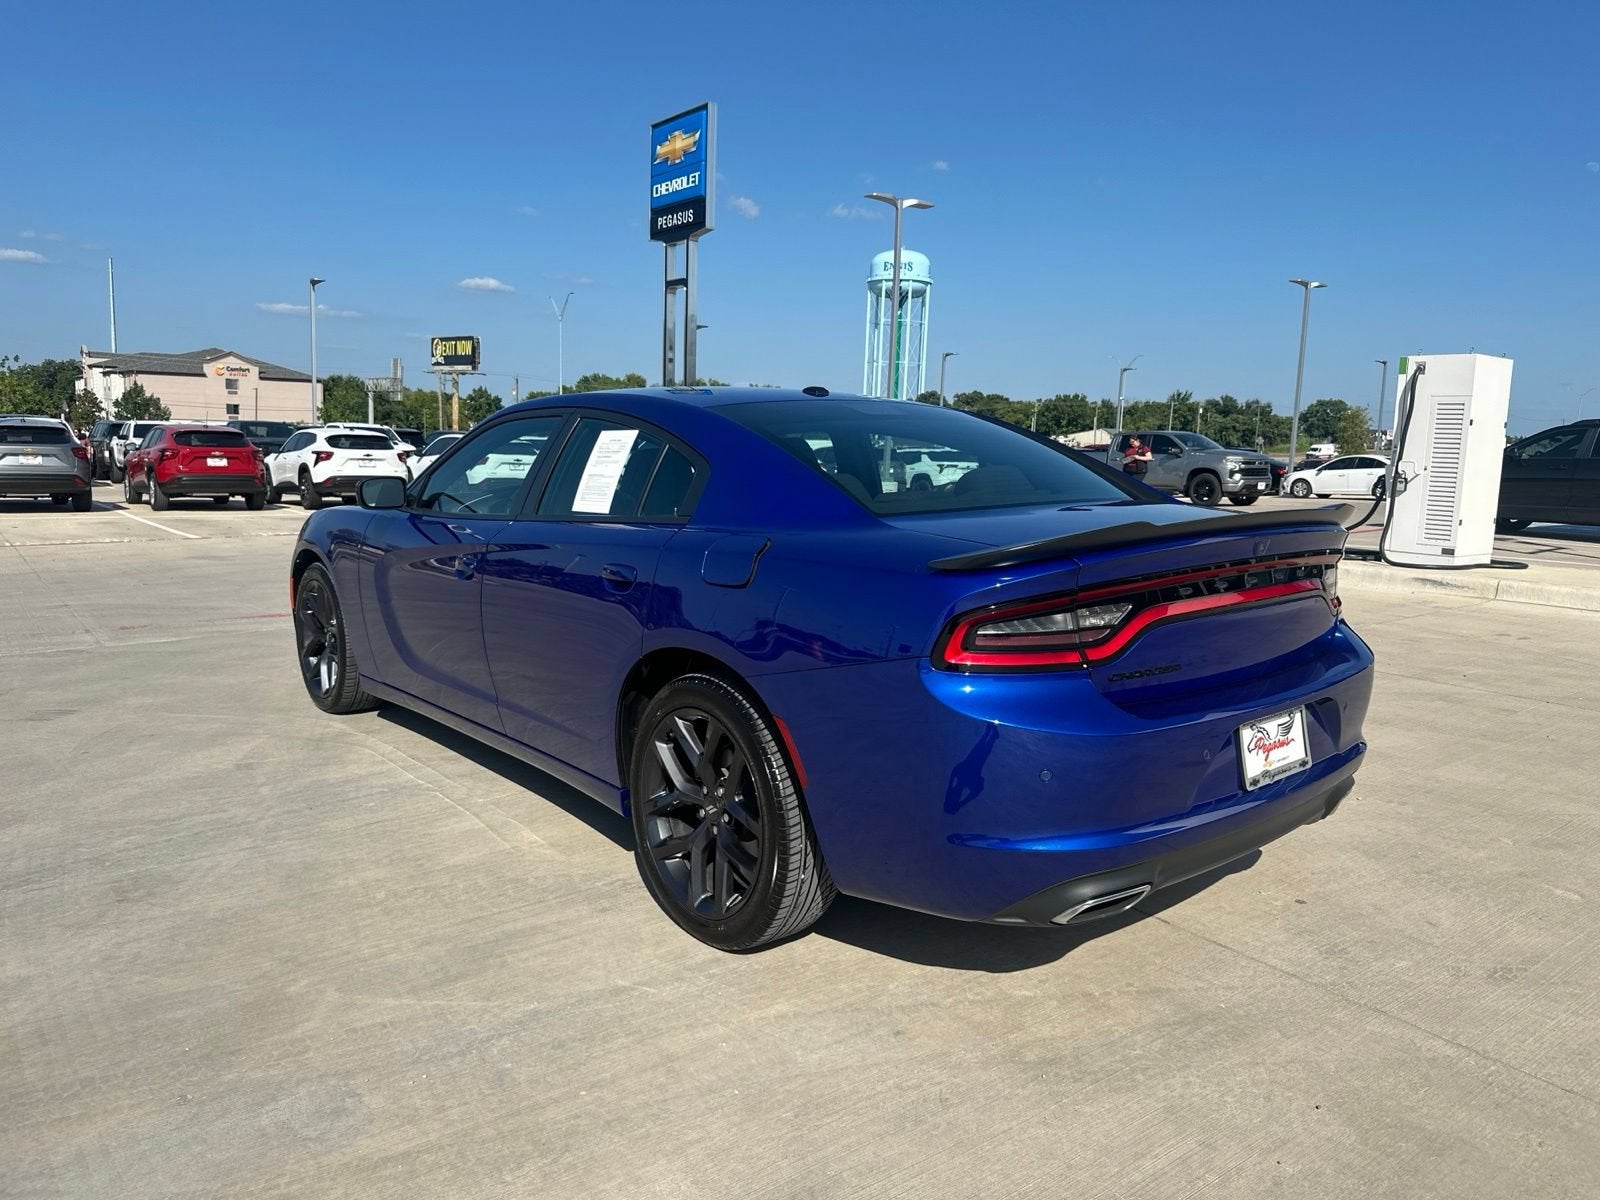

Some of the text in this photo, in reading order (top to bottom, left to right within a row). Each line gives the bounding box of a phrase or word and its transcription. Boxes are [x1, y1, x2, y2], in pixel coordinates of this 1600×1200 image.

[653, 171, 700, 197] CHEVROLET
[657, 209, 694, 229] PEGASUS
[442, 340, 473, 356] EXIT NOW
[1254, 736, 1295, 761] Pegasus
